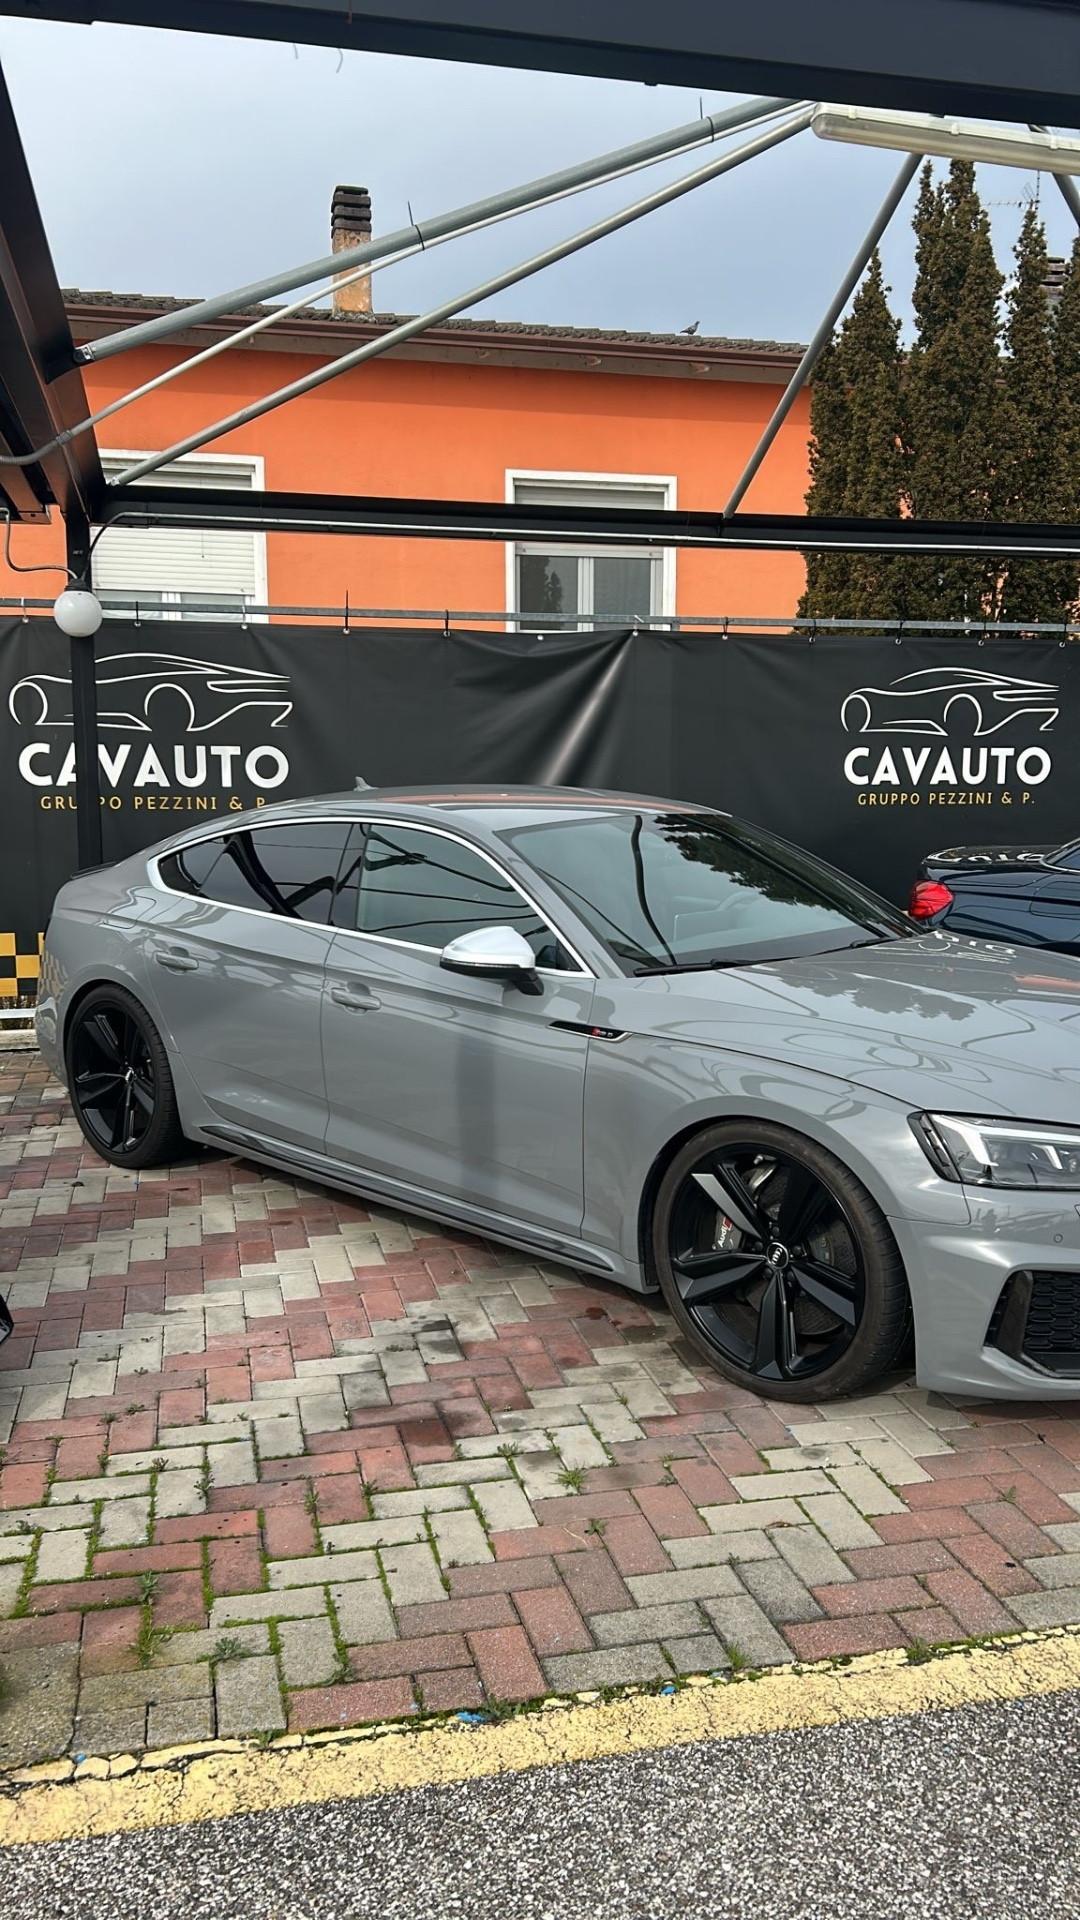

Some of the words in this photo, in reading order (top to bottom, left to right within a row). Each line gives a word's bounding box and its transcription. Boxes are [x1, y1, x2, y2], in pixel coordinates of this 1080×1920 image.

[844, 746, 1051, 785] CAVAUTO
[41, 796, 122, 809] GRUO
[134, 796, 216, 810] PEZZINI
[229, 796, 243, 810] &
[858, 793, 920, 804] GRUPPO
[929, 793, 992, 804] PEZZINI
[1001, 792, 1012, 804] &
[1023, 792, 1035, 804] P.
